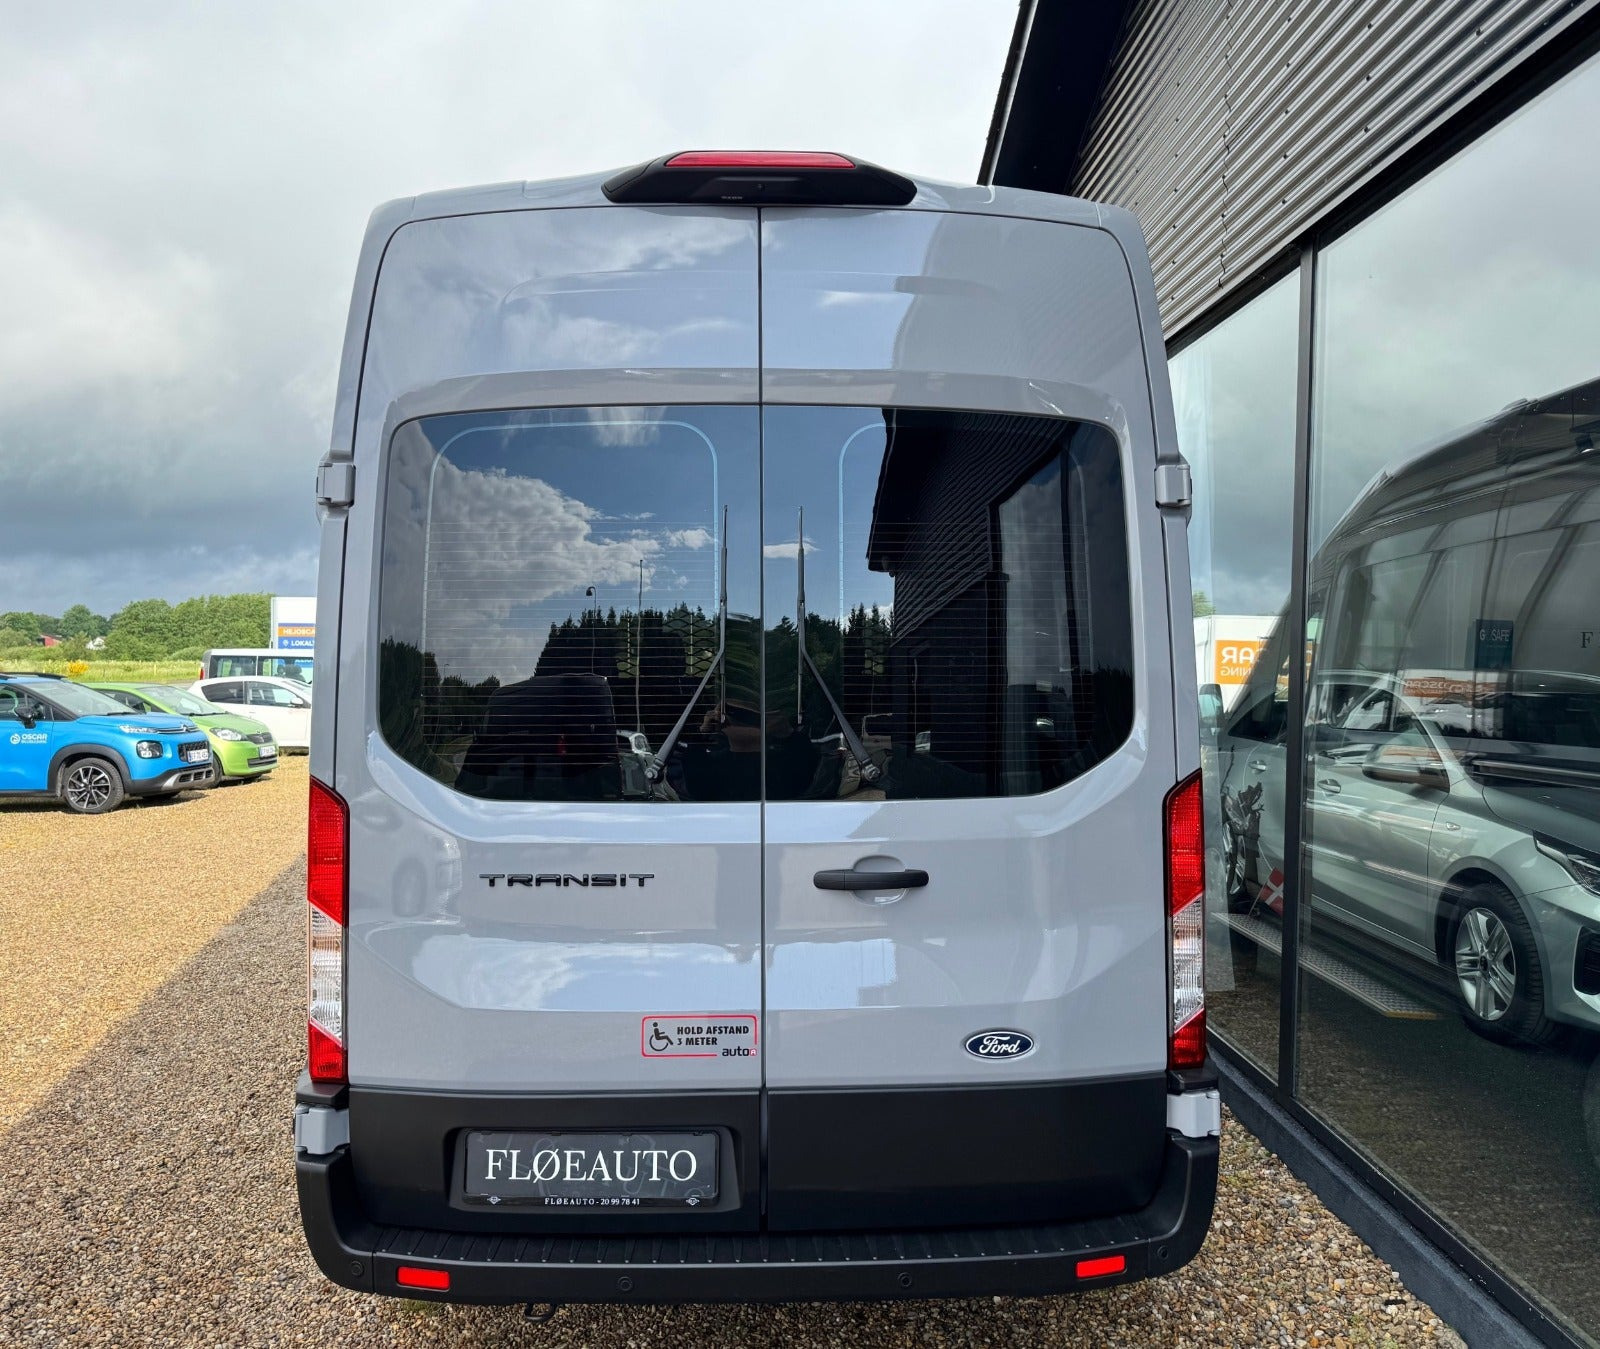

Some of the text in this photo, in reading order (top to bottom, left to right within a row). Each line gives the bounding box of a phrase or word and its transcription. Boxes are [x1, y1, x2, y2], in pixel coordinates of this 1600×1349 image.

[479, 873, 655, 887] TRANSIT
[677, 1025, 749, 1035] HOLD AFSTAND
[677, 1036, 718, 1046] 3 METER
[979, 1035, 1021, 1054] Ford
[484, 1147, 698, 1184] FLØEAUTO
[600, 1198, 610, 1206] 20
